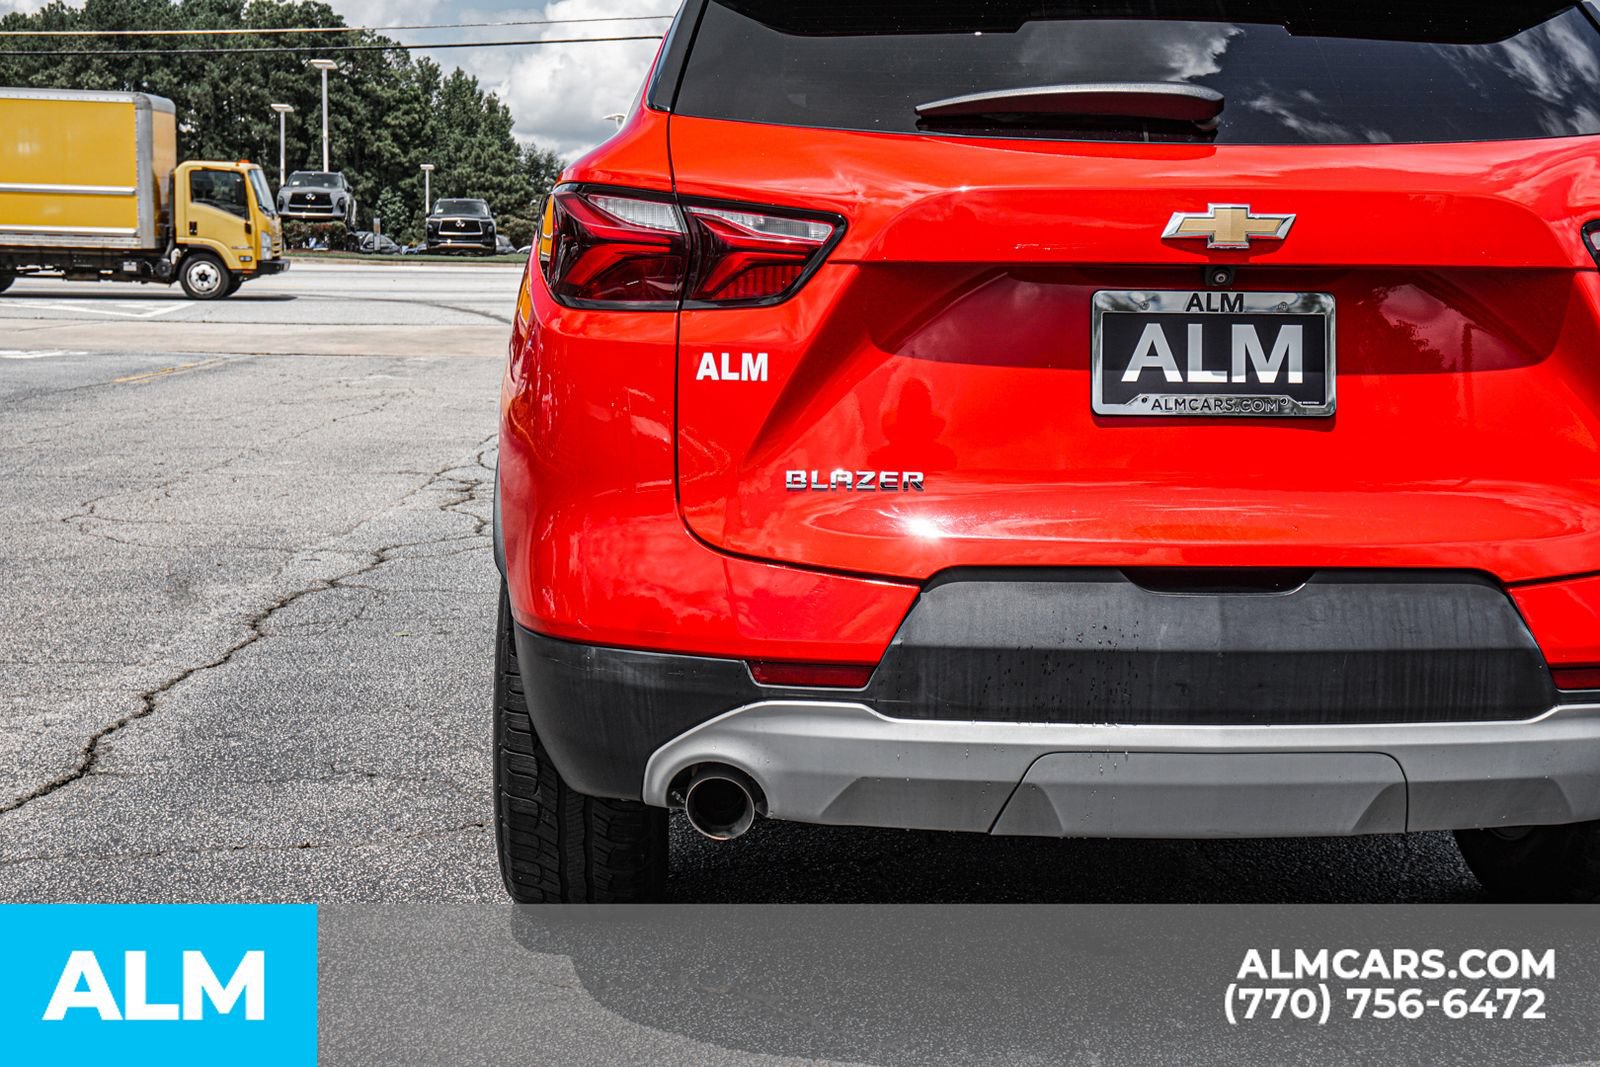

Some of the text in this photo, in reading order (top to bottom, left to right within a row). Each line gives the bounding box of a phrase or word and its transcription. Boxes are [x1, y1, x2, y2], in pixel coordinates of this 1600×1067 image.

[1185, 292, 1245, 313] ALM
[1120, 322, 1304, 384] ALM
[695, 352, 769, 382] ALM
[1151, 398, 1279, 412] ALMCARS.COM
[785, 468, 925, 492] BLAZER
